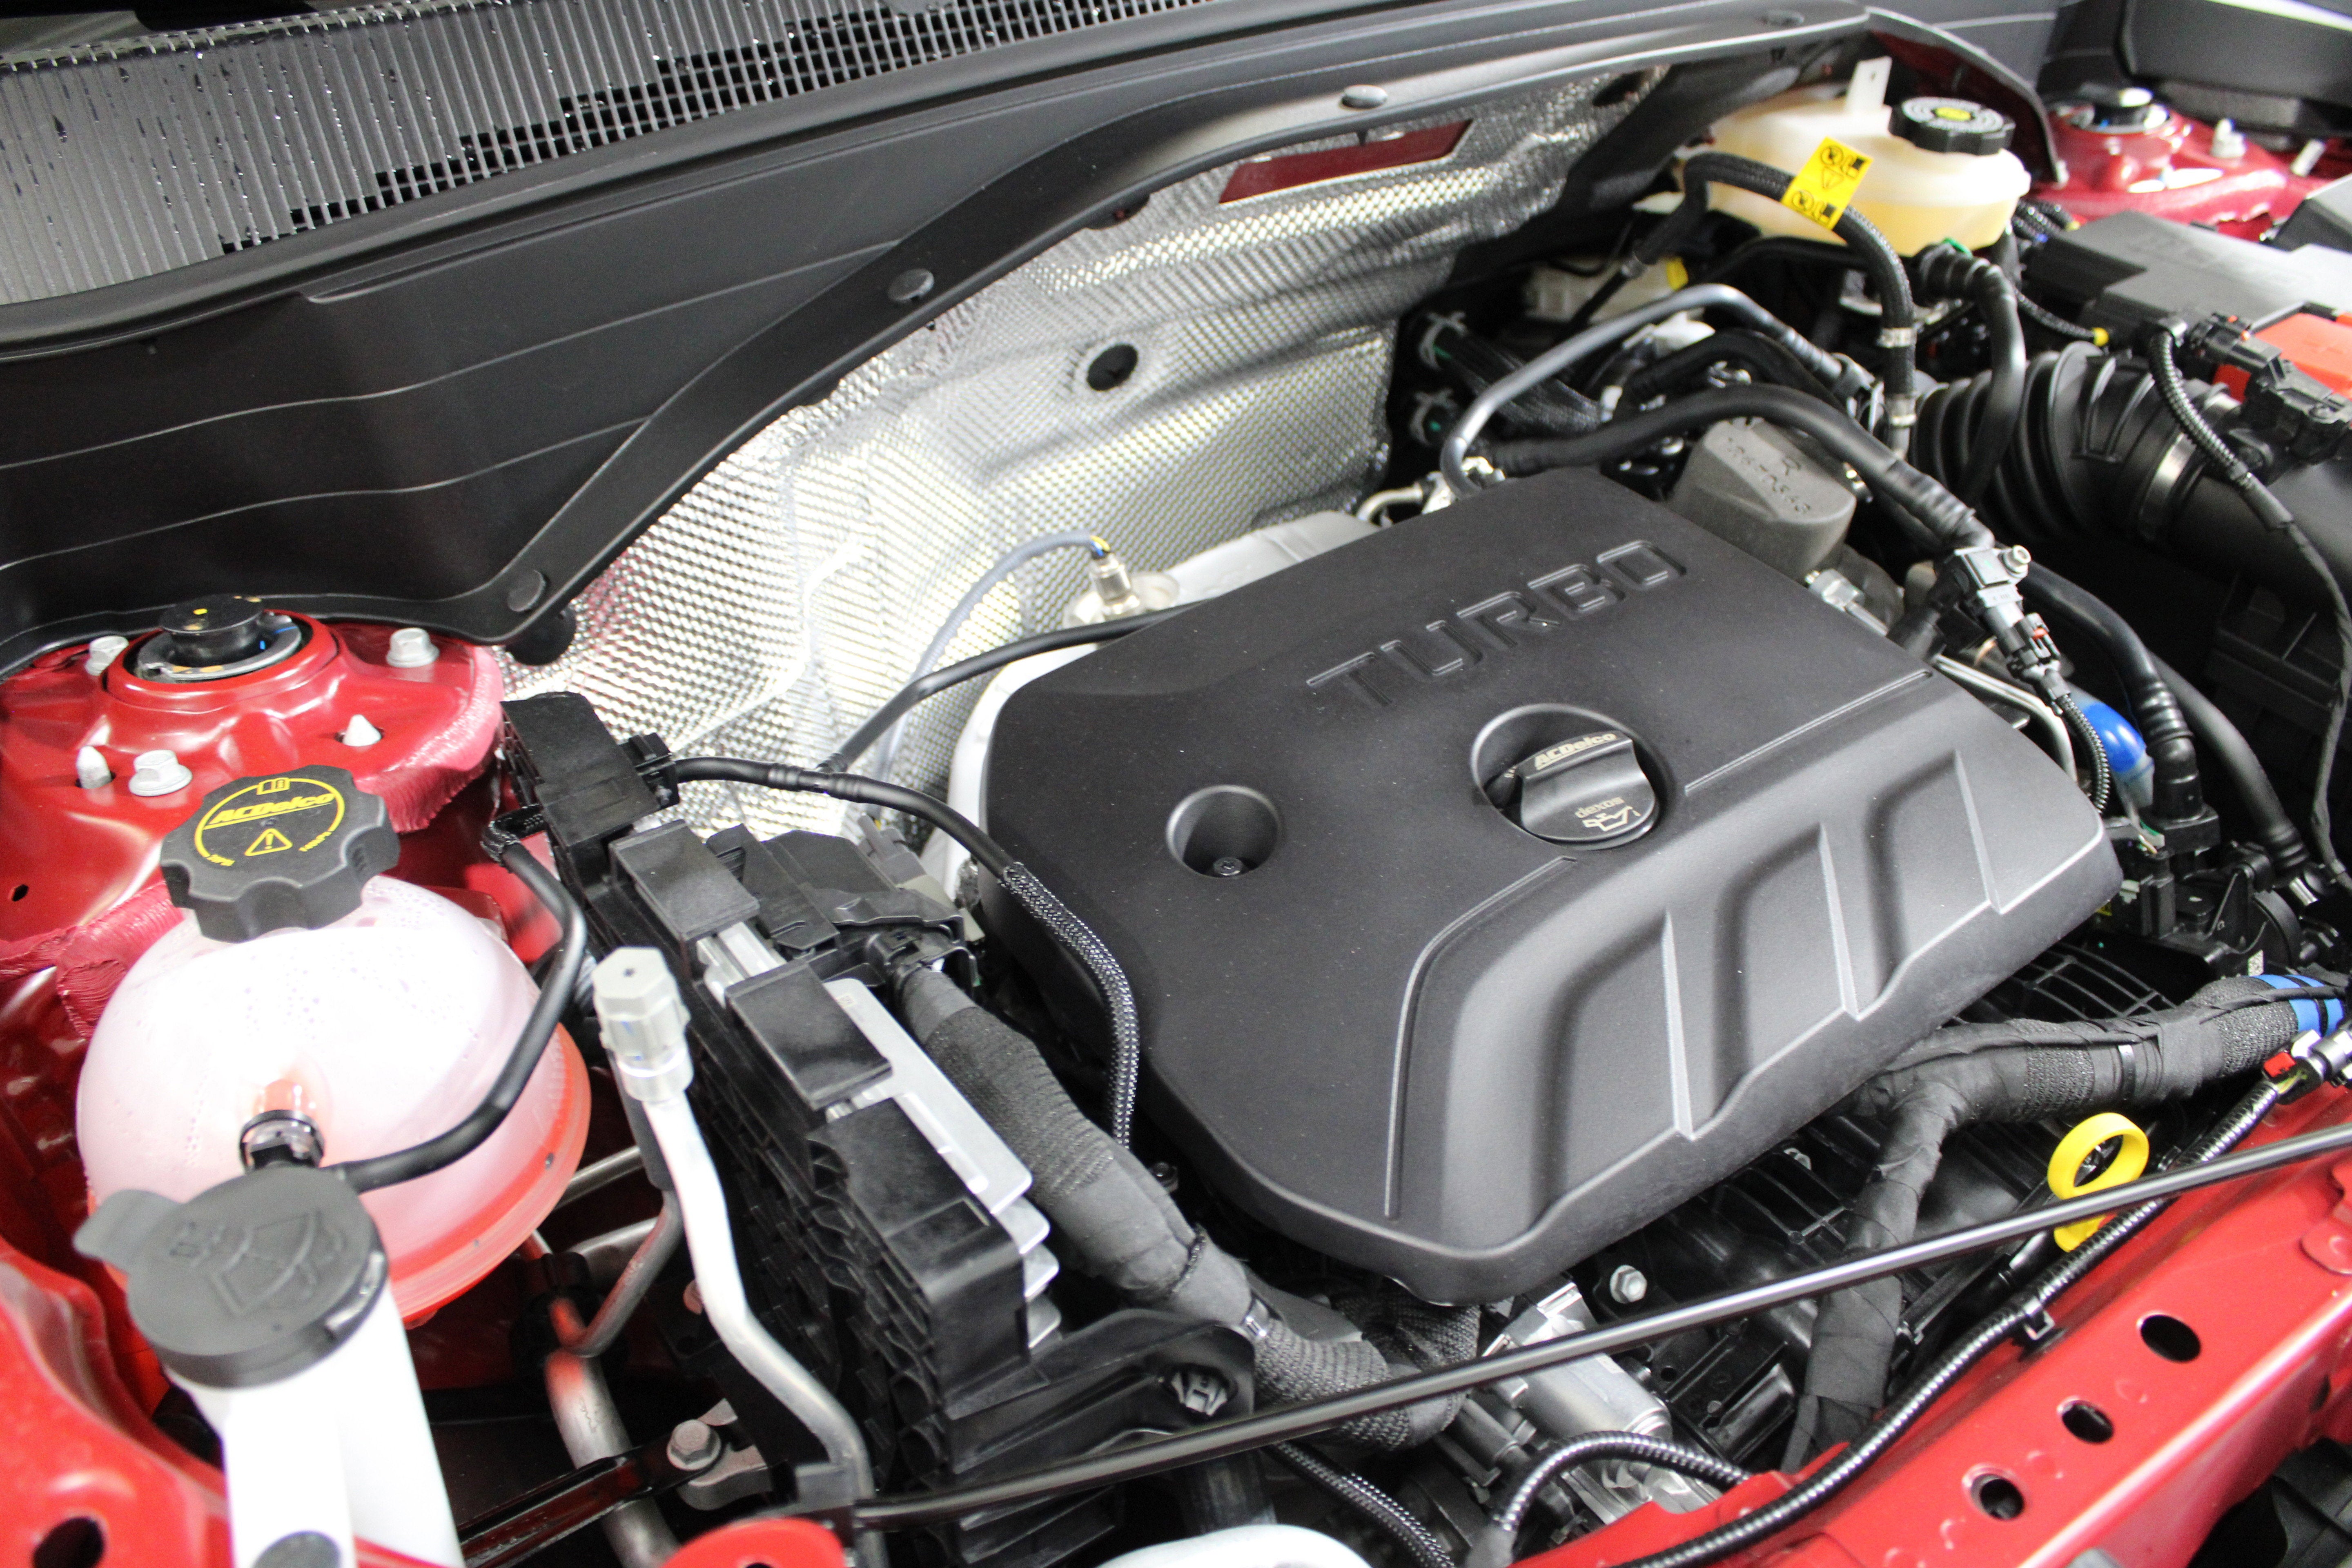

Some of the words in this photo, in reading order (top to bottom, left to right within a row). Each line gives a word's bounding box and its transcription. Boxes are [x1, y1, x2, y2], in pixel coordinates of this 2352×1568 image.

[1305, 539, 1687, 707] TURBO
[1534, 733, 1617, 769] ACDelco
[208, 793, 335, 824] ACDelco
[1575, 797, 1625, 818] dexos
